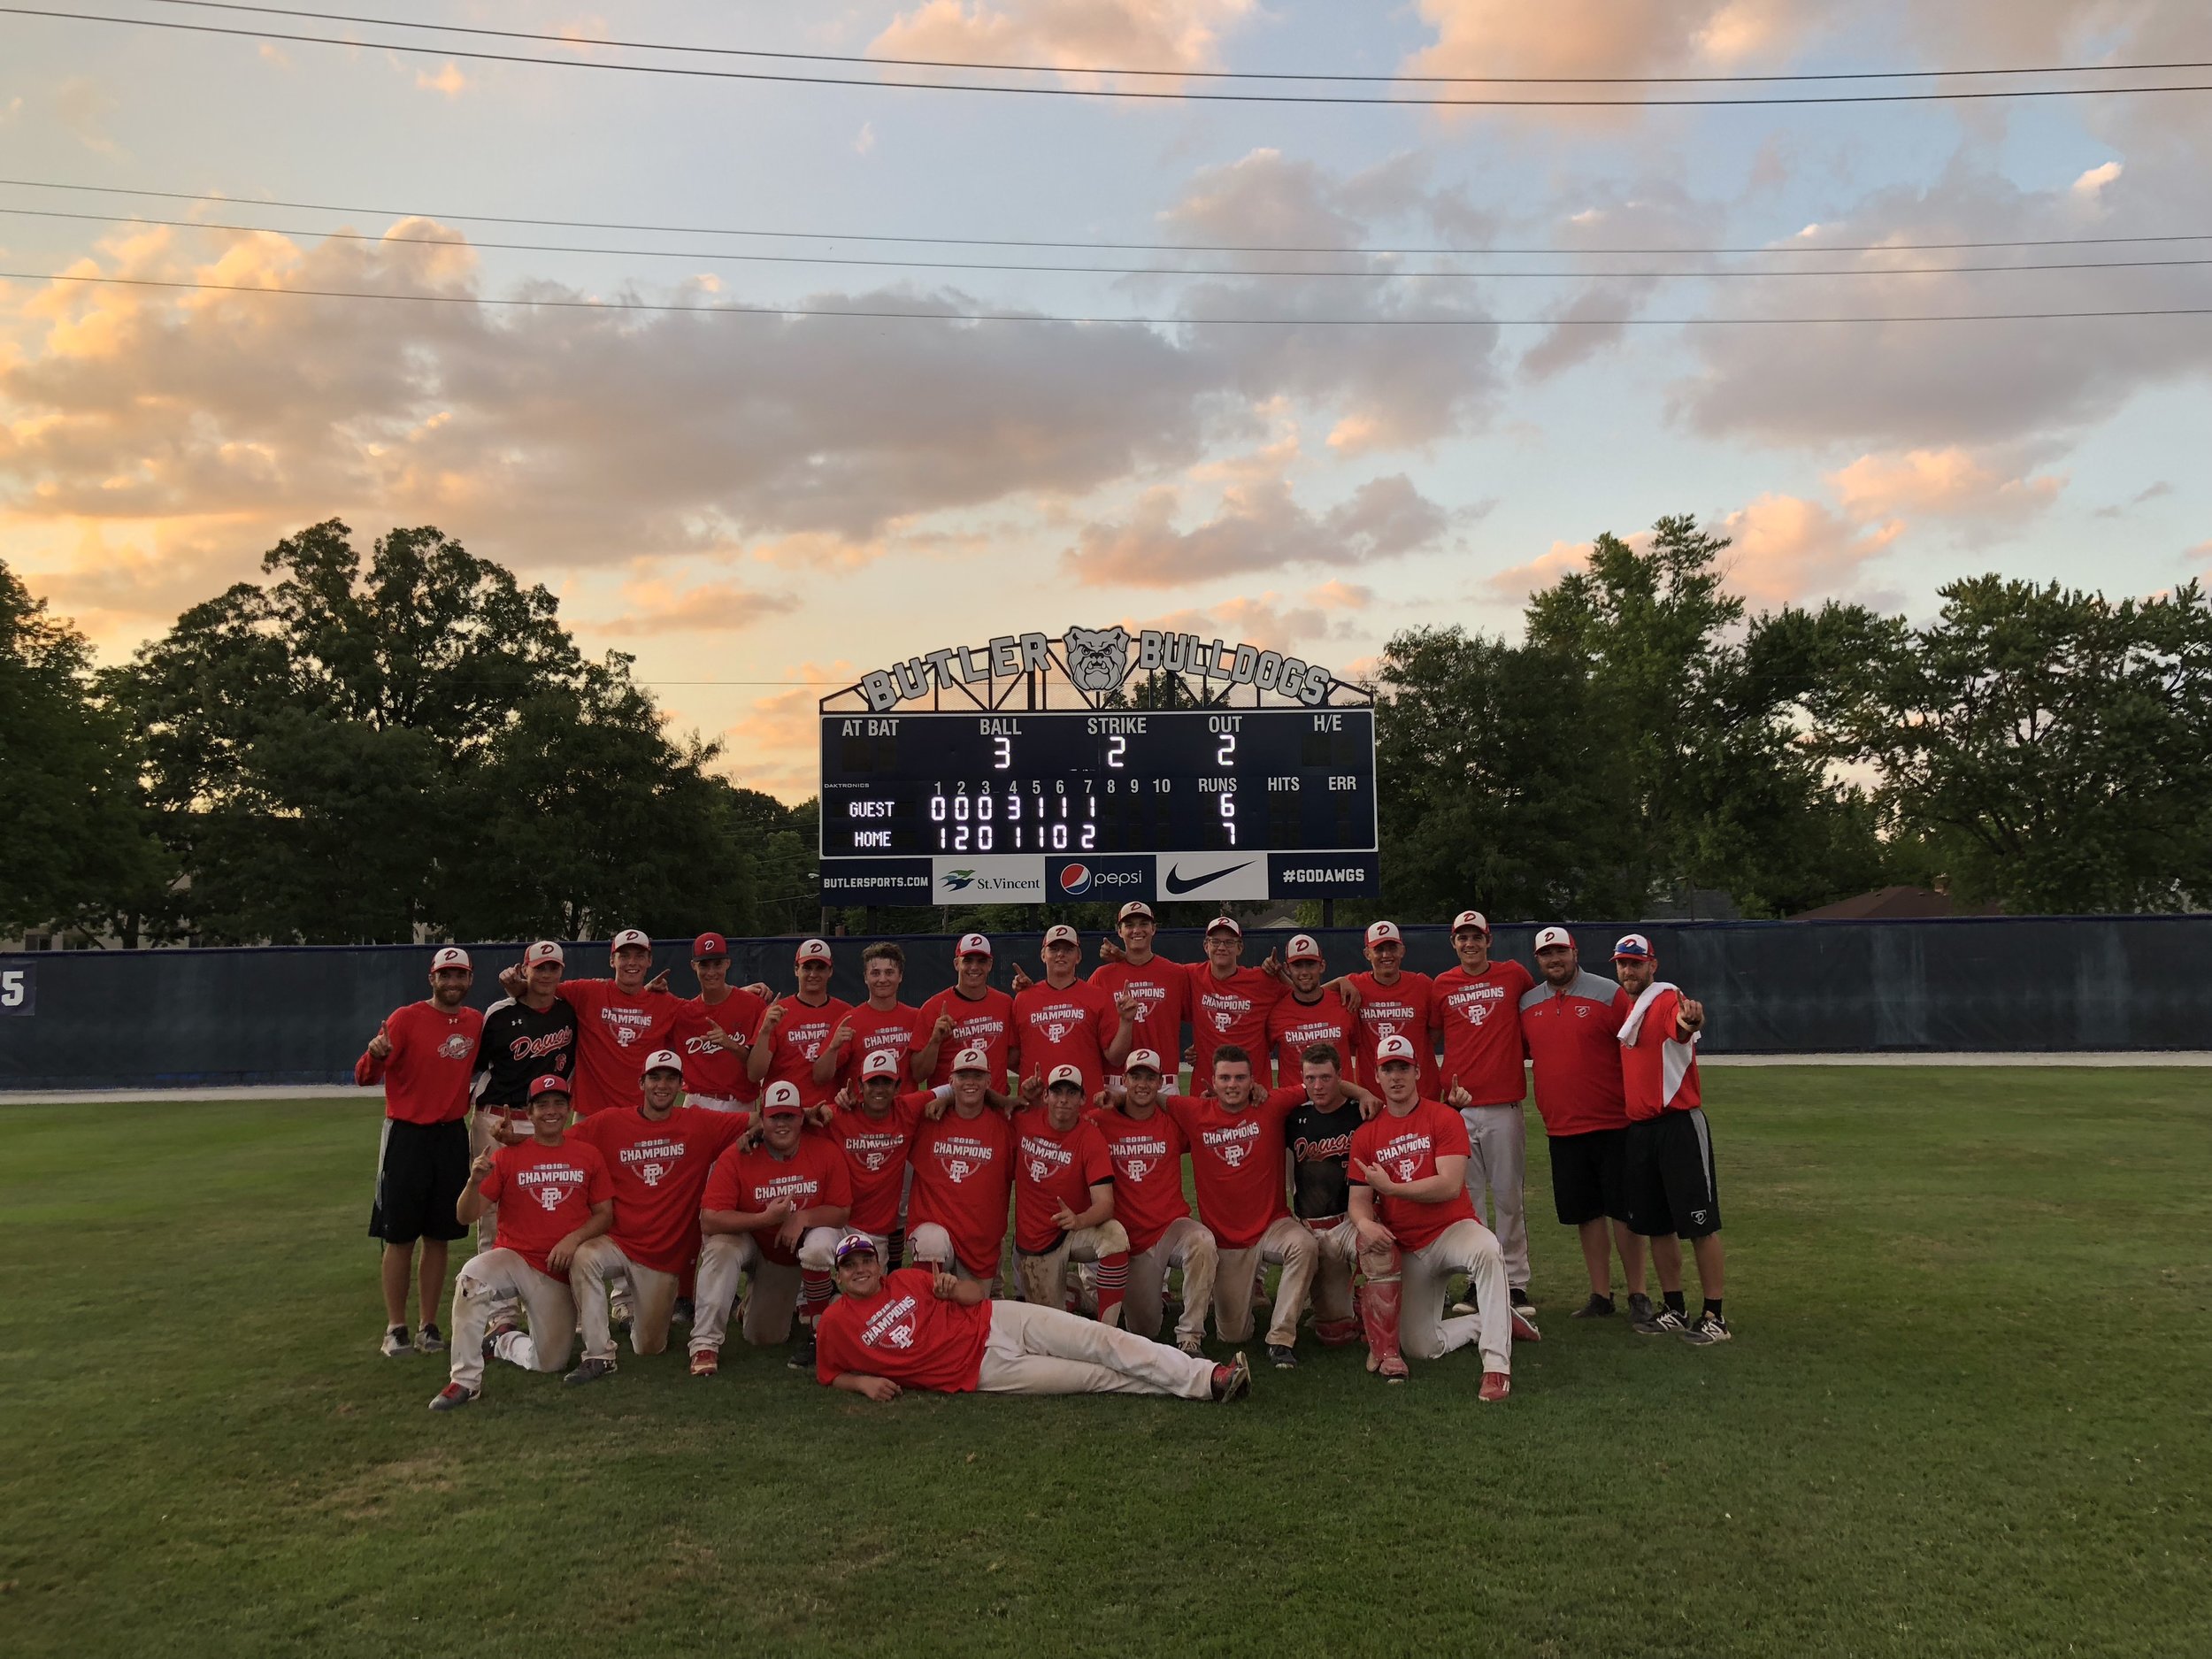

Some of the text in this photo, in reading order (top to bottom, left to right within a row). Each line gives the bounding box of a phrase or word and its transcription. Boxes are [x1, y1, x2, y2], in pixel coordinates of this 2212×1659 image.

[861, 632, 1052, 711] BUTLER
[1139, 629, 1331, 706] BULLDOGS
[841, 718, 900, 737] AT BAT
[979, 718, 1022, 735] BALL
[1087, 717, 1147, 734] STRIKE
[1209, 716, 1242, 733] OUT
[1314, 714, 1342, 733] H/E
[994, 737, 1011, 769] 3
[1107, 736, 1125, 767] 2
[1217, 734, 1236, 765] 2
[934, 776, 1356, 795] 1 2 3 4 5 6 7 8 9 10 RUNS HITS ERR
[849, 793, 1235, 821] GUEST 0 0 0 3 1 1 1 6
[854, 822, 1236, 850] HOME 1 2 0 1 1 0 2 7
[824, 876, 929, 889] BUTLERSPORTS.COM
[1094, 870, 1142, 887] pepsi
[1282, 868, 1365, 883] #GODAWGS
[0, 971, 24, 1007] 5
[1448, 987, 1504, 1006] CHAMPIONS
[1202, 994, 1251, 1010] CHAMPIONS
[601, 1007, 652, 1027] CHAMPIONS
[1031, 1009, 1085, 1024] CHAMPIONS
[1360, 1007, 1415, 1018] CHAMPIONS
[953, 1021, 1003, 1039] CHAMPIONS
[1286, 1026, 1341, 1041] CHAMPIONS
[846, 1133, 903, 1149] CHAMPIONS
[1202, 1122, 1260, 1145] CHAMPIONS
[619, 1143, 684, 1163] CHAMPIONS
[933, 1141, 993, 1160] CHAMPIONS
[1021, 1136, 1072, 1164] CHAMPIONS
[1376, 1135, 1431, 1162] CHAMPIONS
[518, 1170, 584, 1186] CHAMPIONS
[755, 1180, 818, 1200] CHAMPIONS
[861, 1295, 916, 1346] CHAMPIONS
